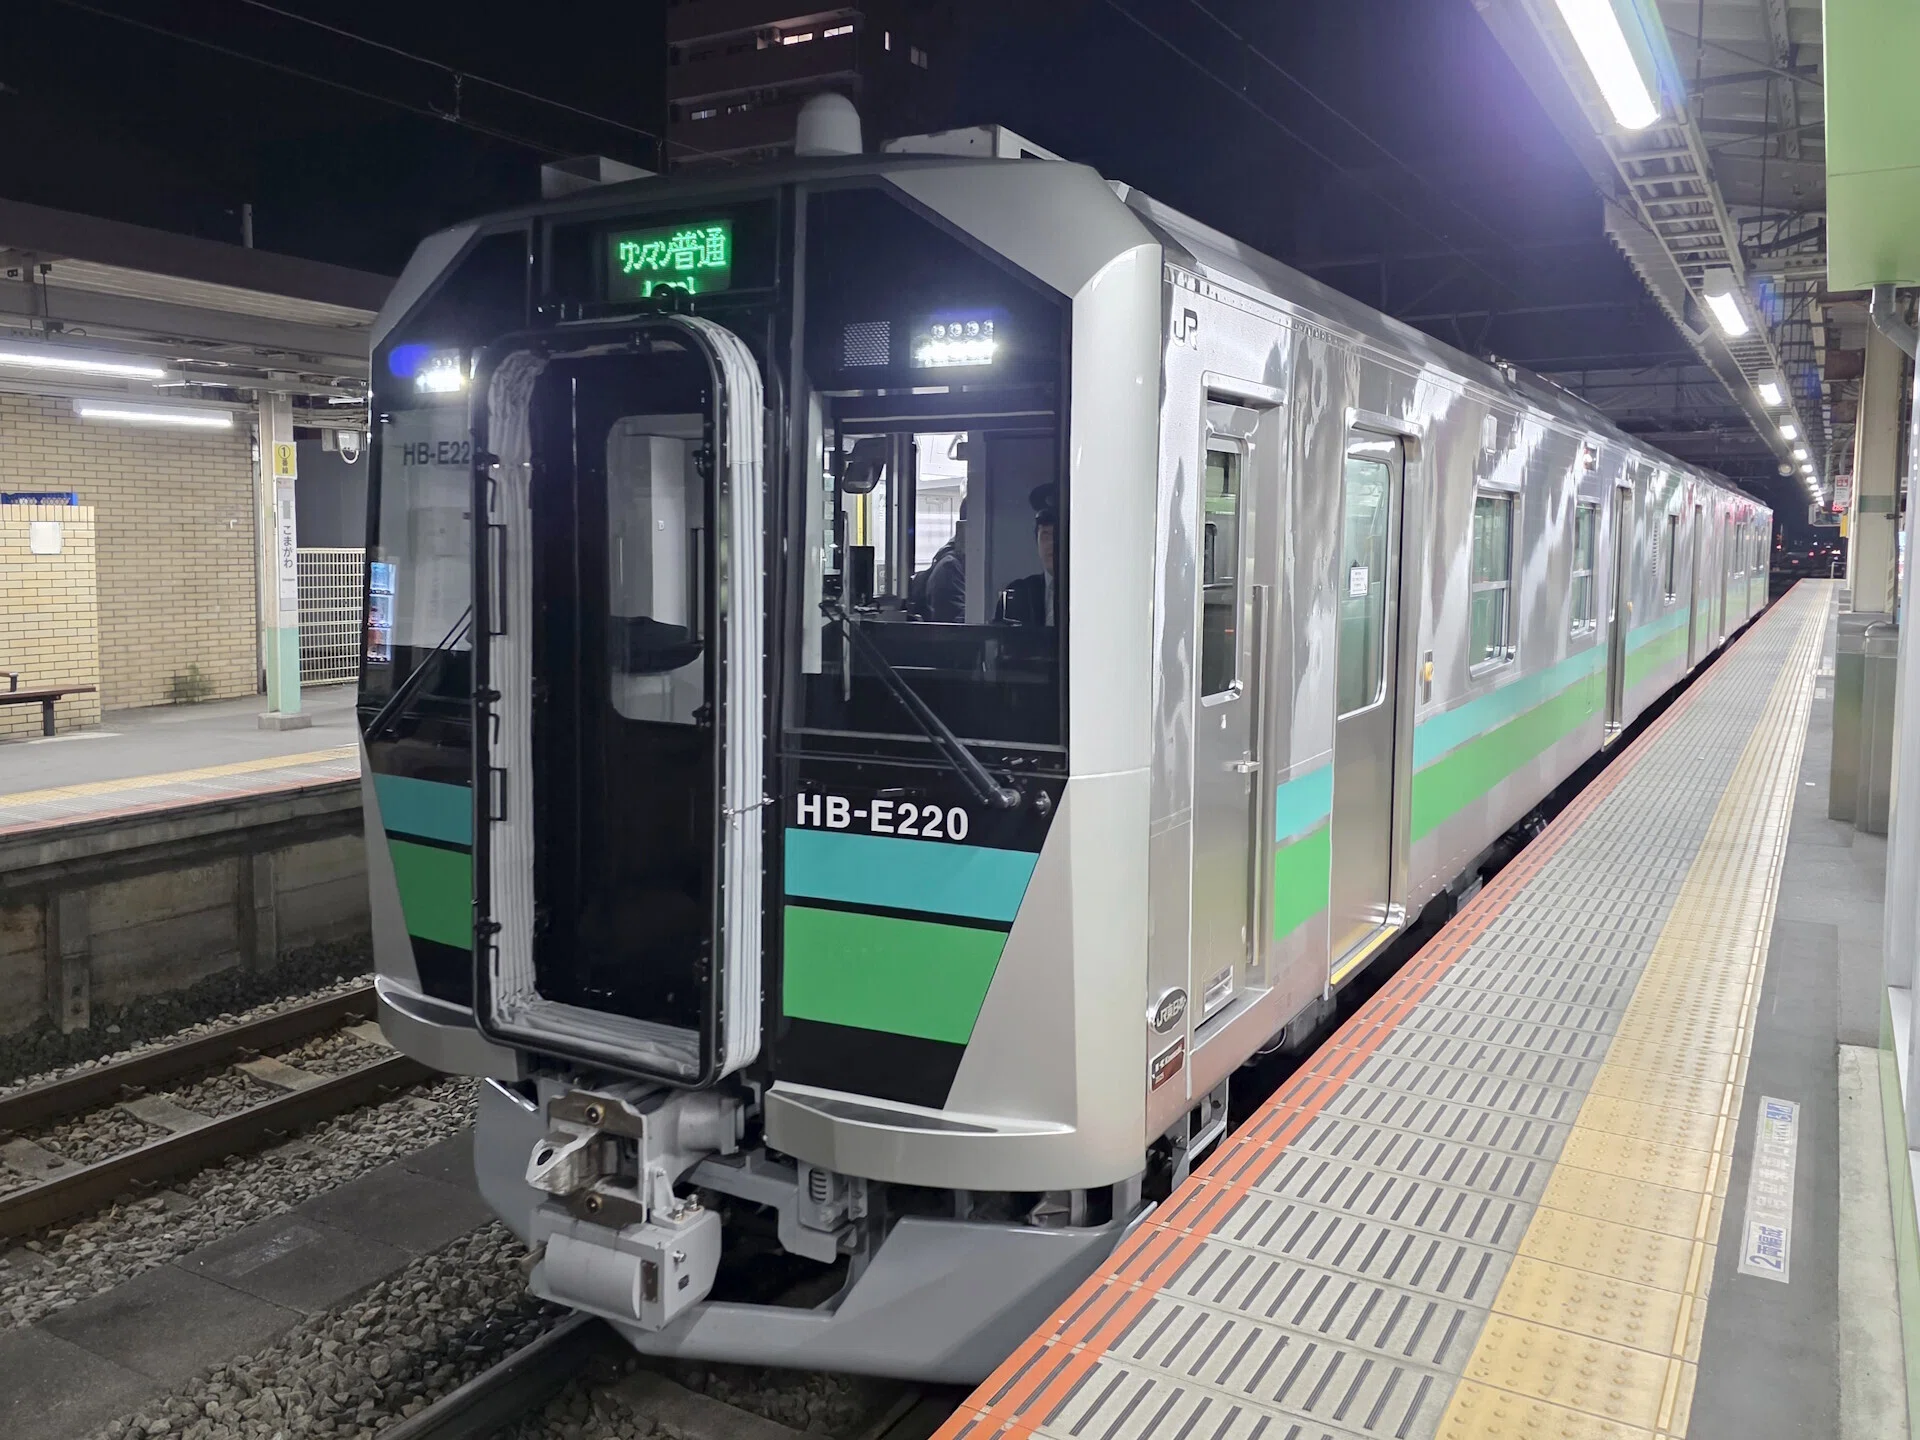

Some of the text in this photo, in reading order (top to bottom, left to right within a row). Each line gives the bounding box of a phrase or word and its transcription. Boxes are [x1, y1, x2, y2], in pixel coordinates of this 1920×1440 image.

[1173, 308, 1198, 350] JR
[403, 441, 470, 465] HB-E22
[282, 525, 294, 568] こまがわ
[797, 793, 969, 841] HB-E220
[1749, 1226, 1783, 1270] 2両編成
